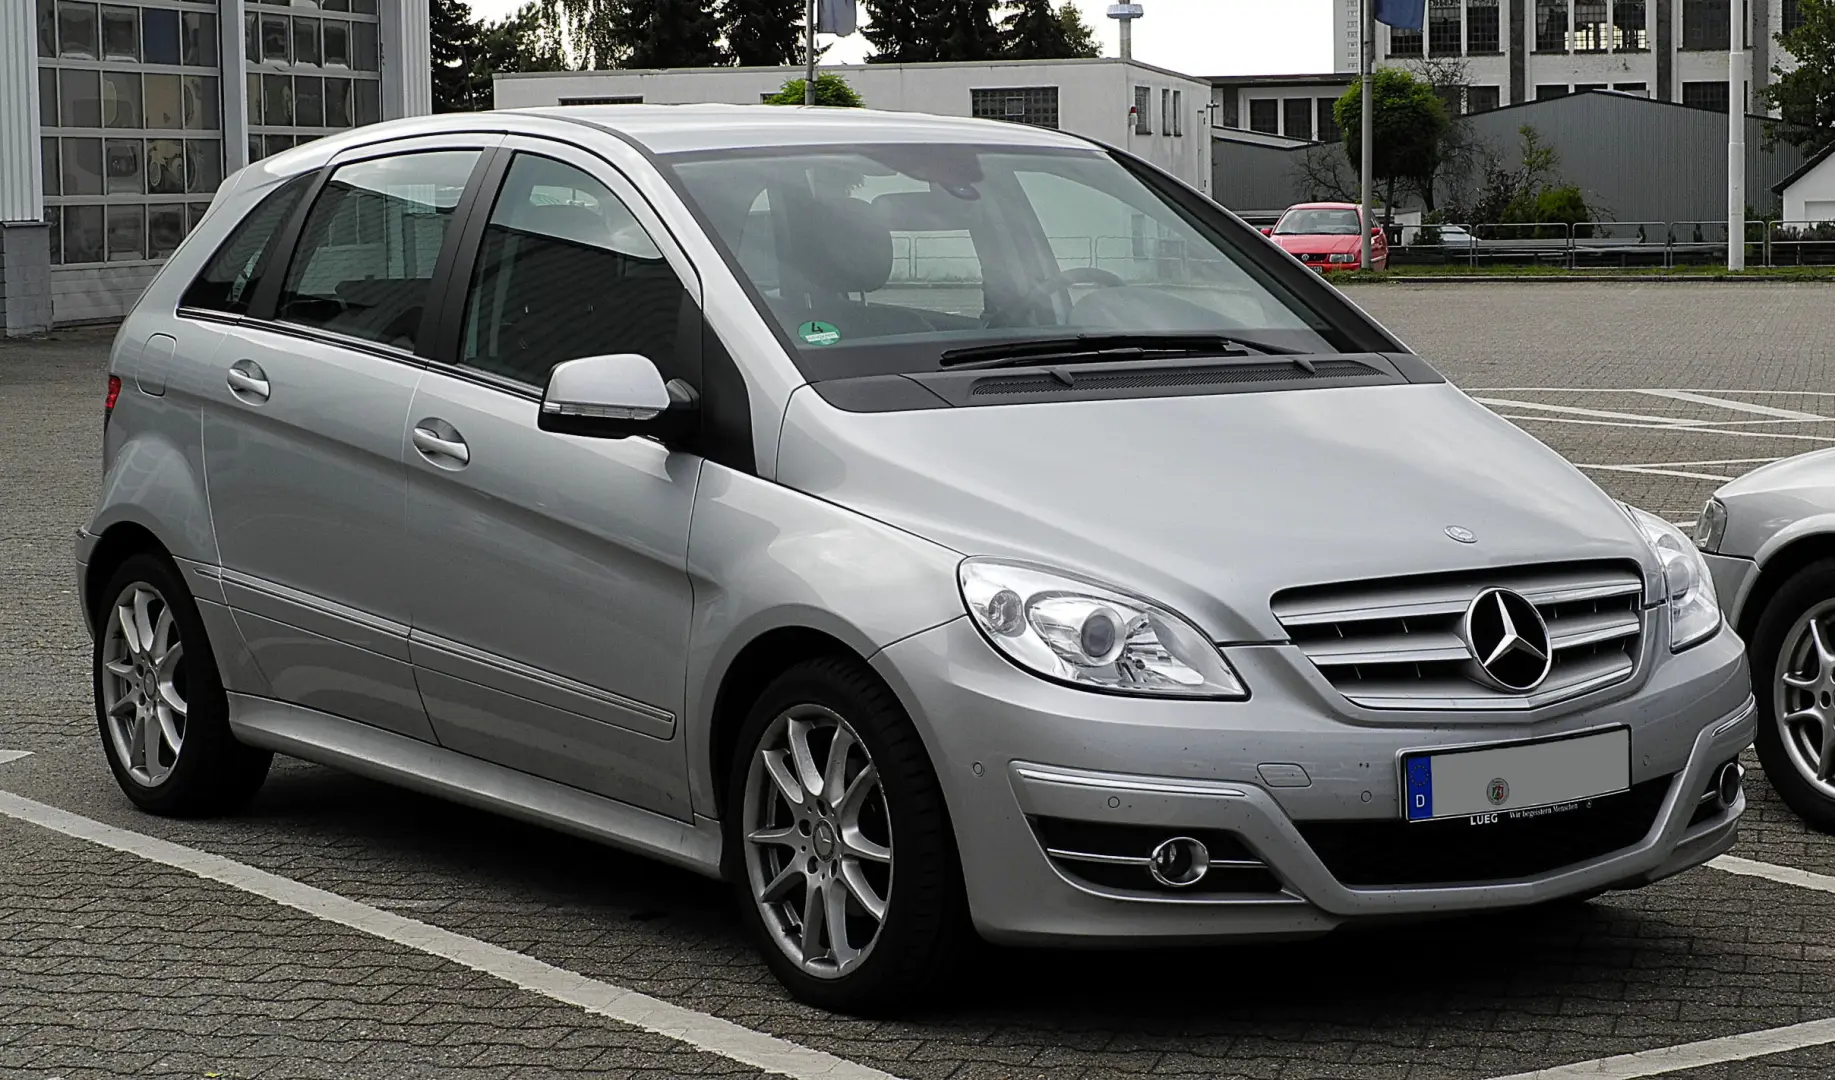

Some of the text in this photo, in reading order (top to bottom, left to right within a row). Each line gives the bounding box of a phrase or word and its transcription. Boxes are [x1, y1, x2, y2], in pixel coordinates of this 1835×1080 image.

[1416, 794, 1425, 808] D
[1509, 803, 1578, 819] Wir begeistern Menschen
[1470, 813, 1498, 826] LUEG
